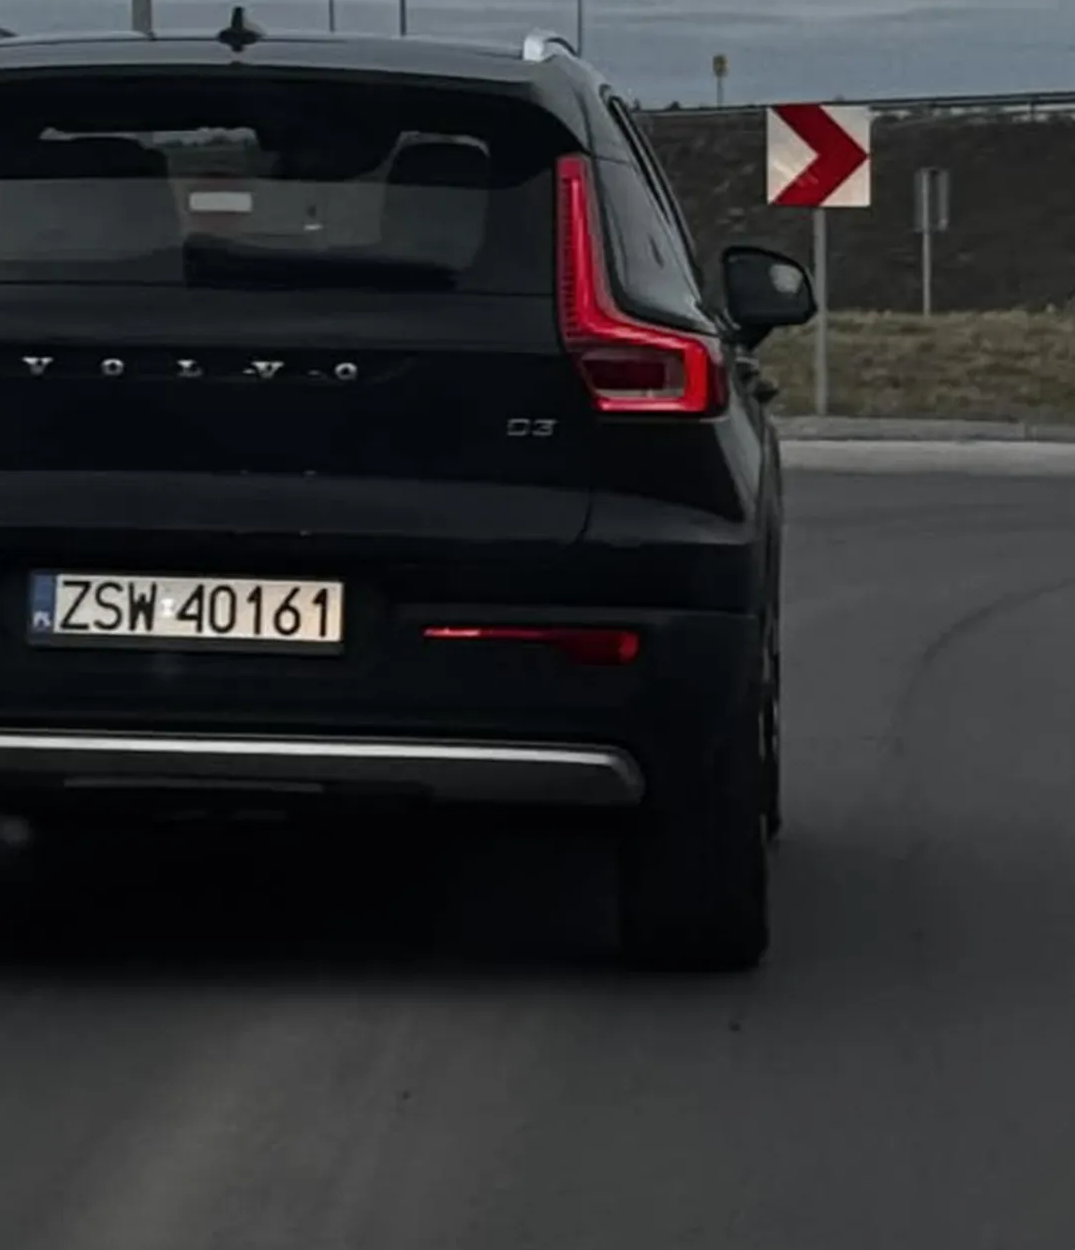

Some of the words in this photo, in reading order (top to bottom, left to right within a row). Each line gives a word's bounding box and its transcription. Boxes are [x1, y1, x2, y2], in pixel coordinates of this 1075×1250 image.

[22, 356, 358, 379] VOLVO
[59, 580, 157, 632] ZSW
[176, 583, 329, 638] 40161
